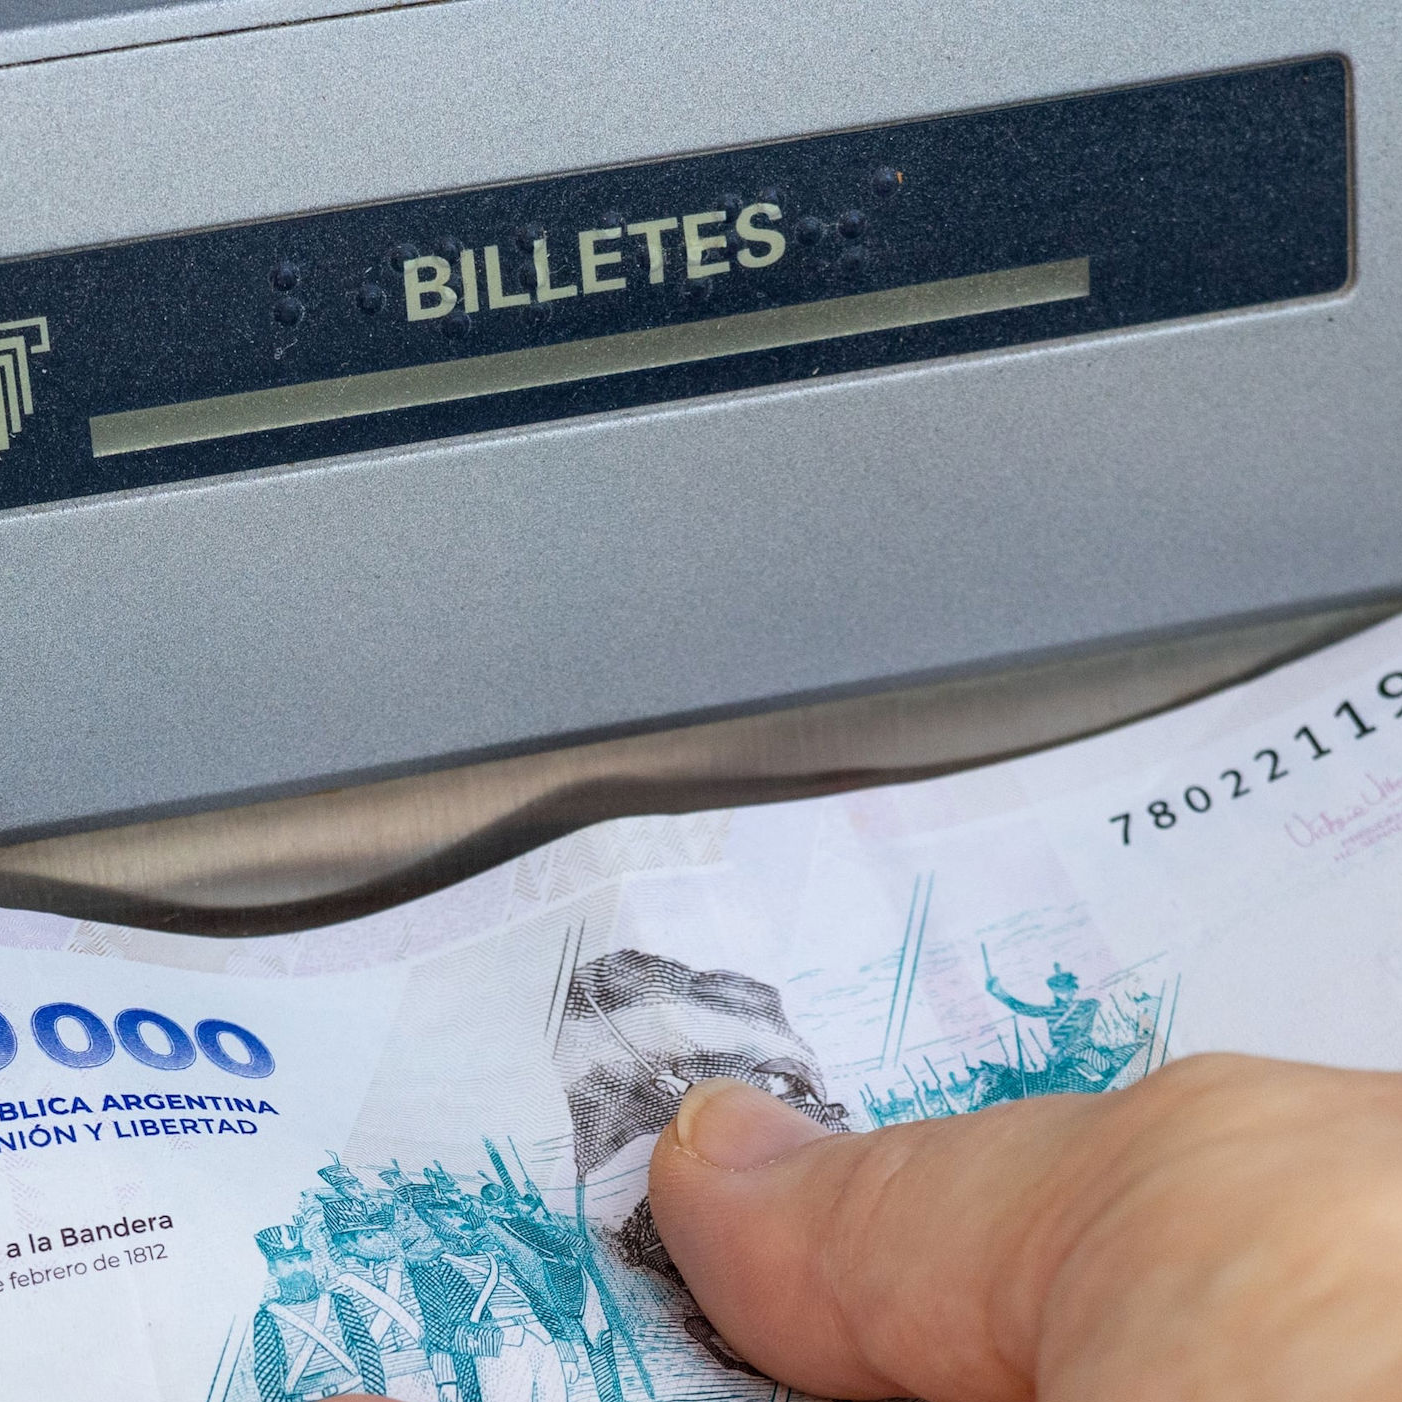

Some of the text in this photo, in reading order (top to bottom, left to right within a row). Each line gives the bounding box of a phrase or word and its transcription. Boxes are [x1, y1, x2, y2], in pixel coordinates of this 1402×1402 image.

[402, 202, 787, 322] BILLETES
[101, 1093, 280, 1116] ARGENTINA
[84, 1122, 109, 1142] Y
[114, 1117, 259, 1139] LIBERTAD
[5, 1241, 22, 1259] a
[28, 1233, 53, 1255] la
[60, 1213, 175, 1248] Bandera
[8, 1261, 89, 1291] febrero
[93, 1253, 121, 1272] de
[124, 1243, 169, 1267] 1812
